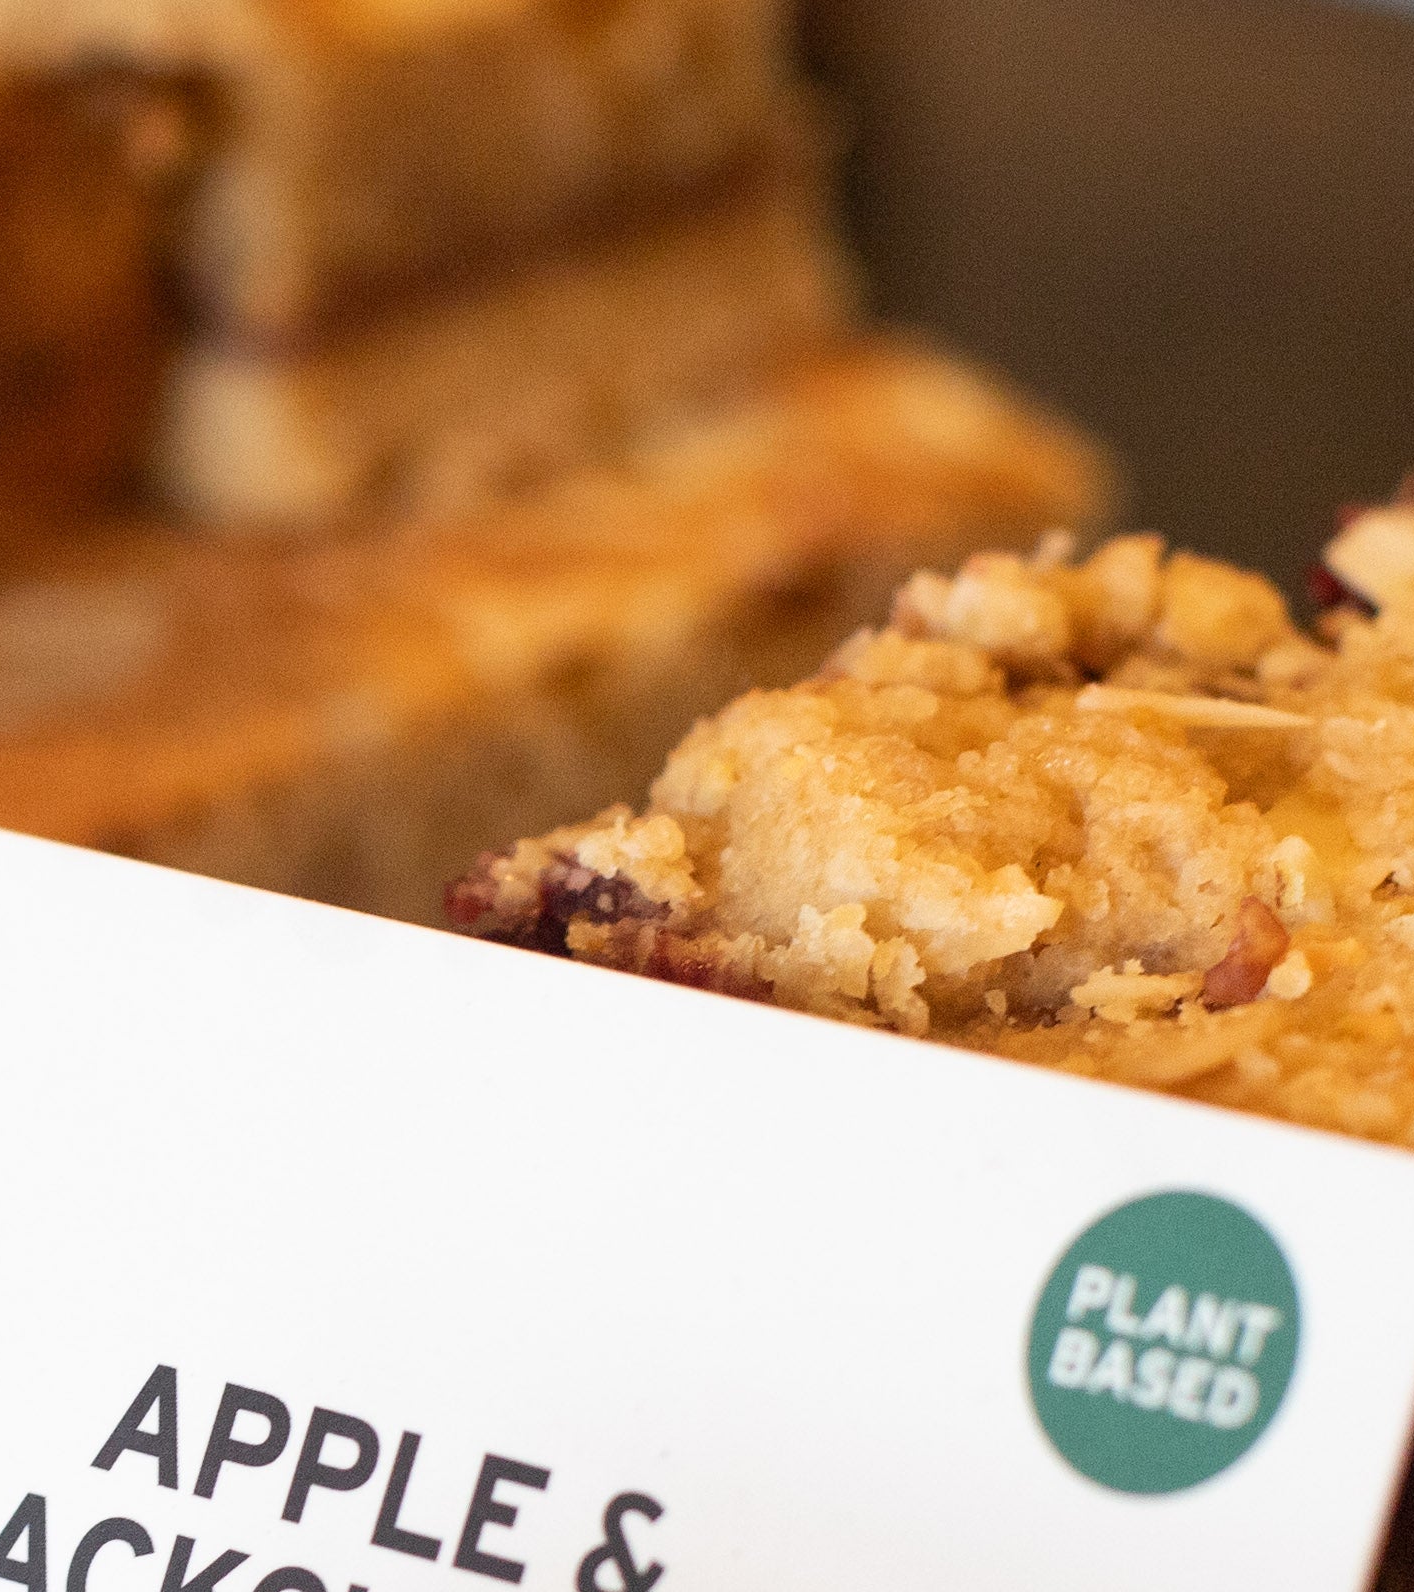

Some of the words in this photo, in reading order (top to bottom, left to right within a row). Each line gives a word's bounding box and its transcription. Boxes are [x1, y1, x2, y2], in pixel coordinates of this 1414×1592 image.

[1066, 1263, 1283, 1368] PLANT
[1046, 1325, 1261, 1430] BASED
[90, 1363, 551, 1585] APPLE
